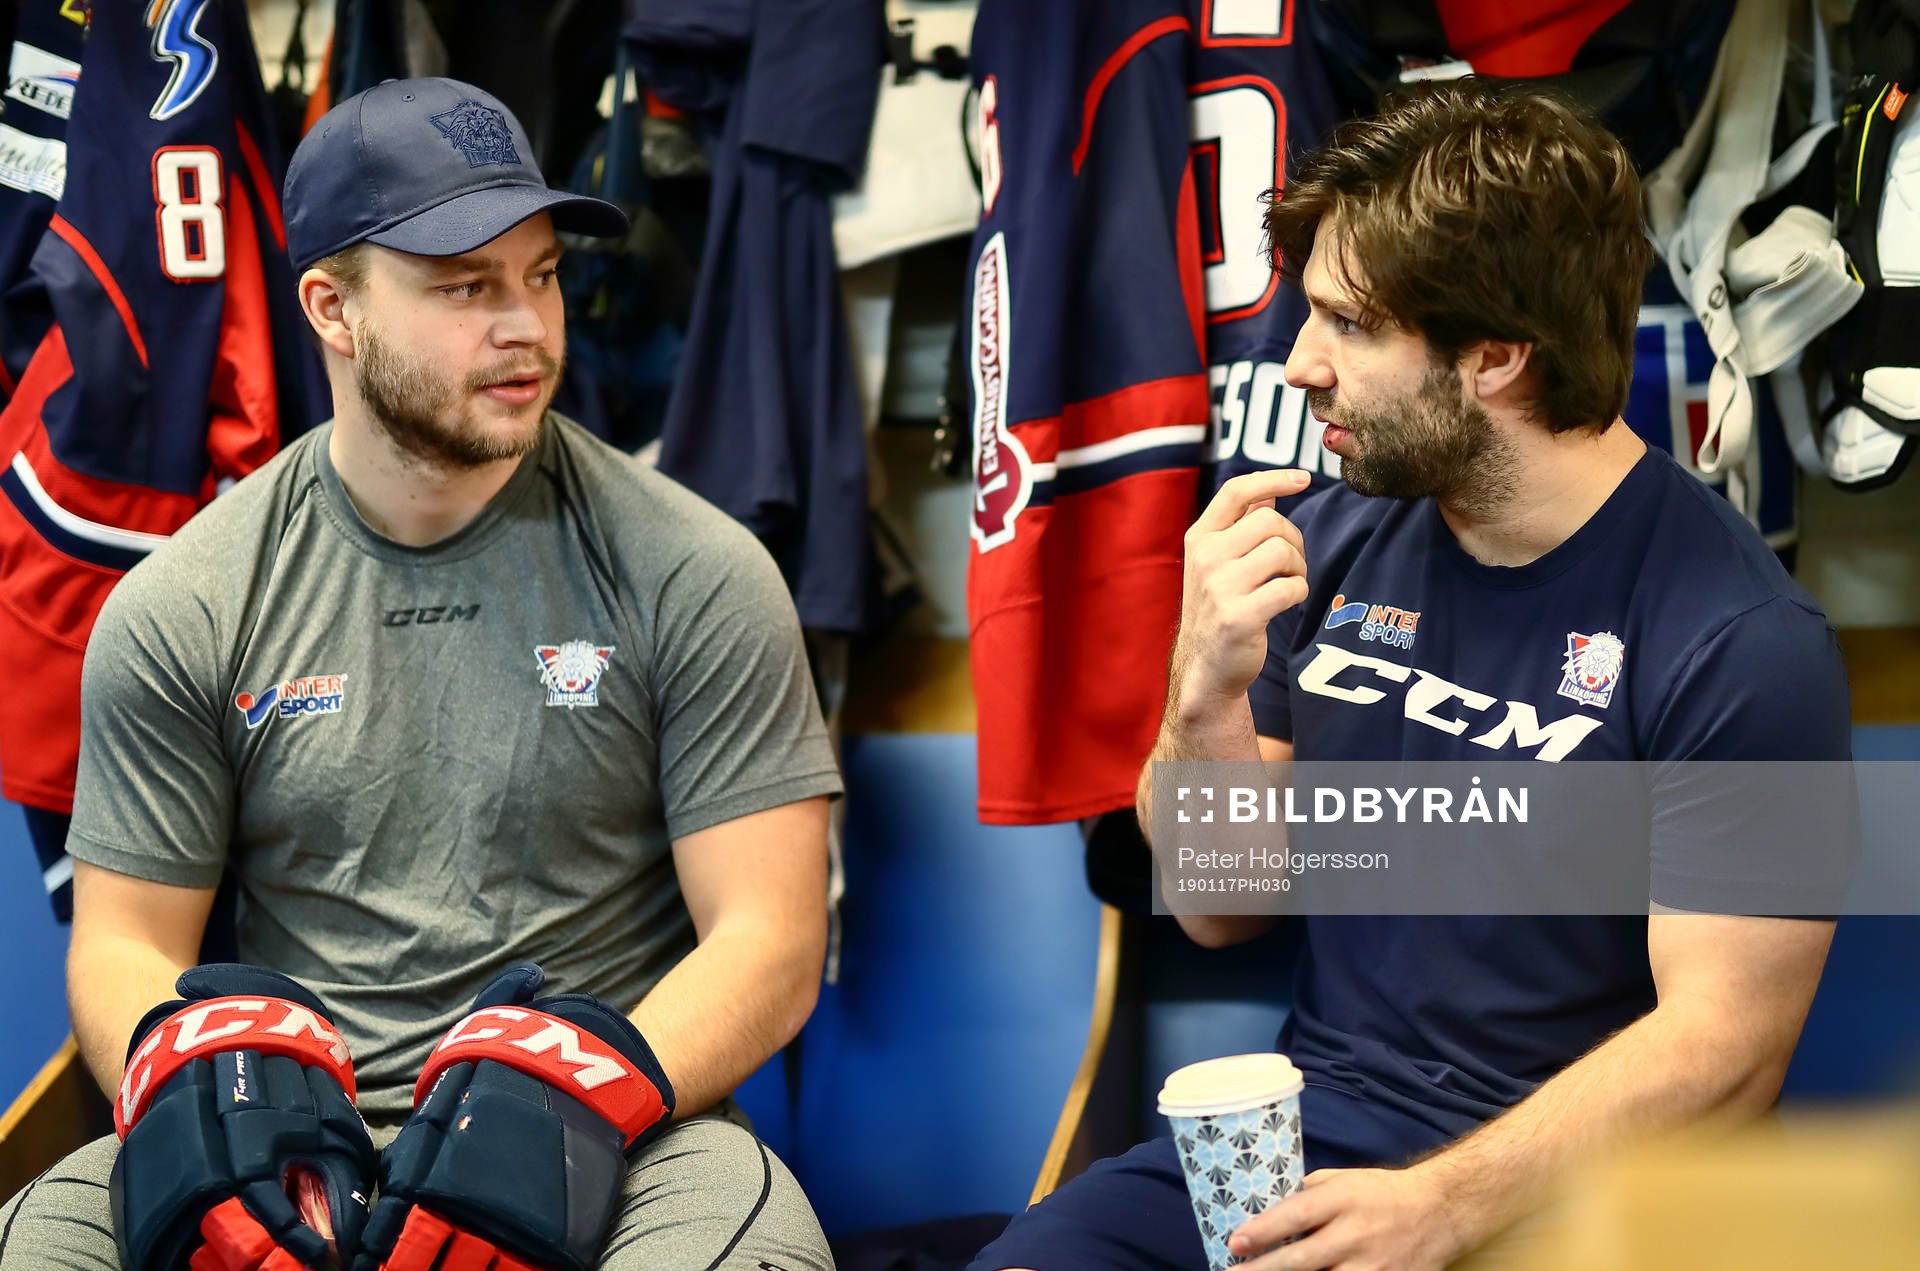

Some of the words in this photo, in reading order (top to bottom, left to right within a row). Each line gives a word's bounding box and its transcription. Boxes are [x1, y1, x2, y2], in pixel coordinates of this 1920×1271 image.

[153, 146, 226, 284] 8
[382, 604, 480, 627] CCM
[279, 676, 343, 700] INTER
[279, 694, 343, 717] SPORT
[1297, 643, 1604, 764] CCM
[119, 1000, 351, 1126] CCM
[438, 1007, 629, 1090] CM
